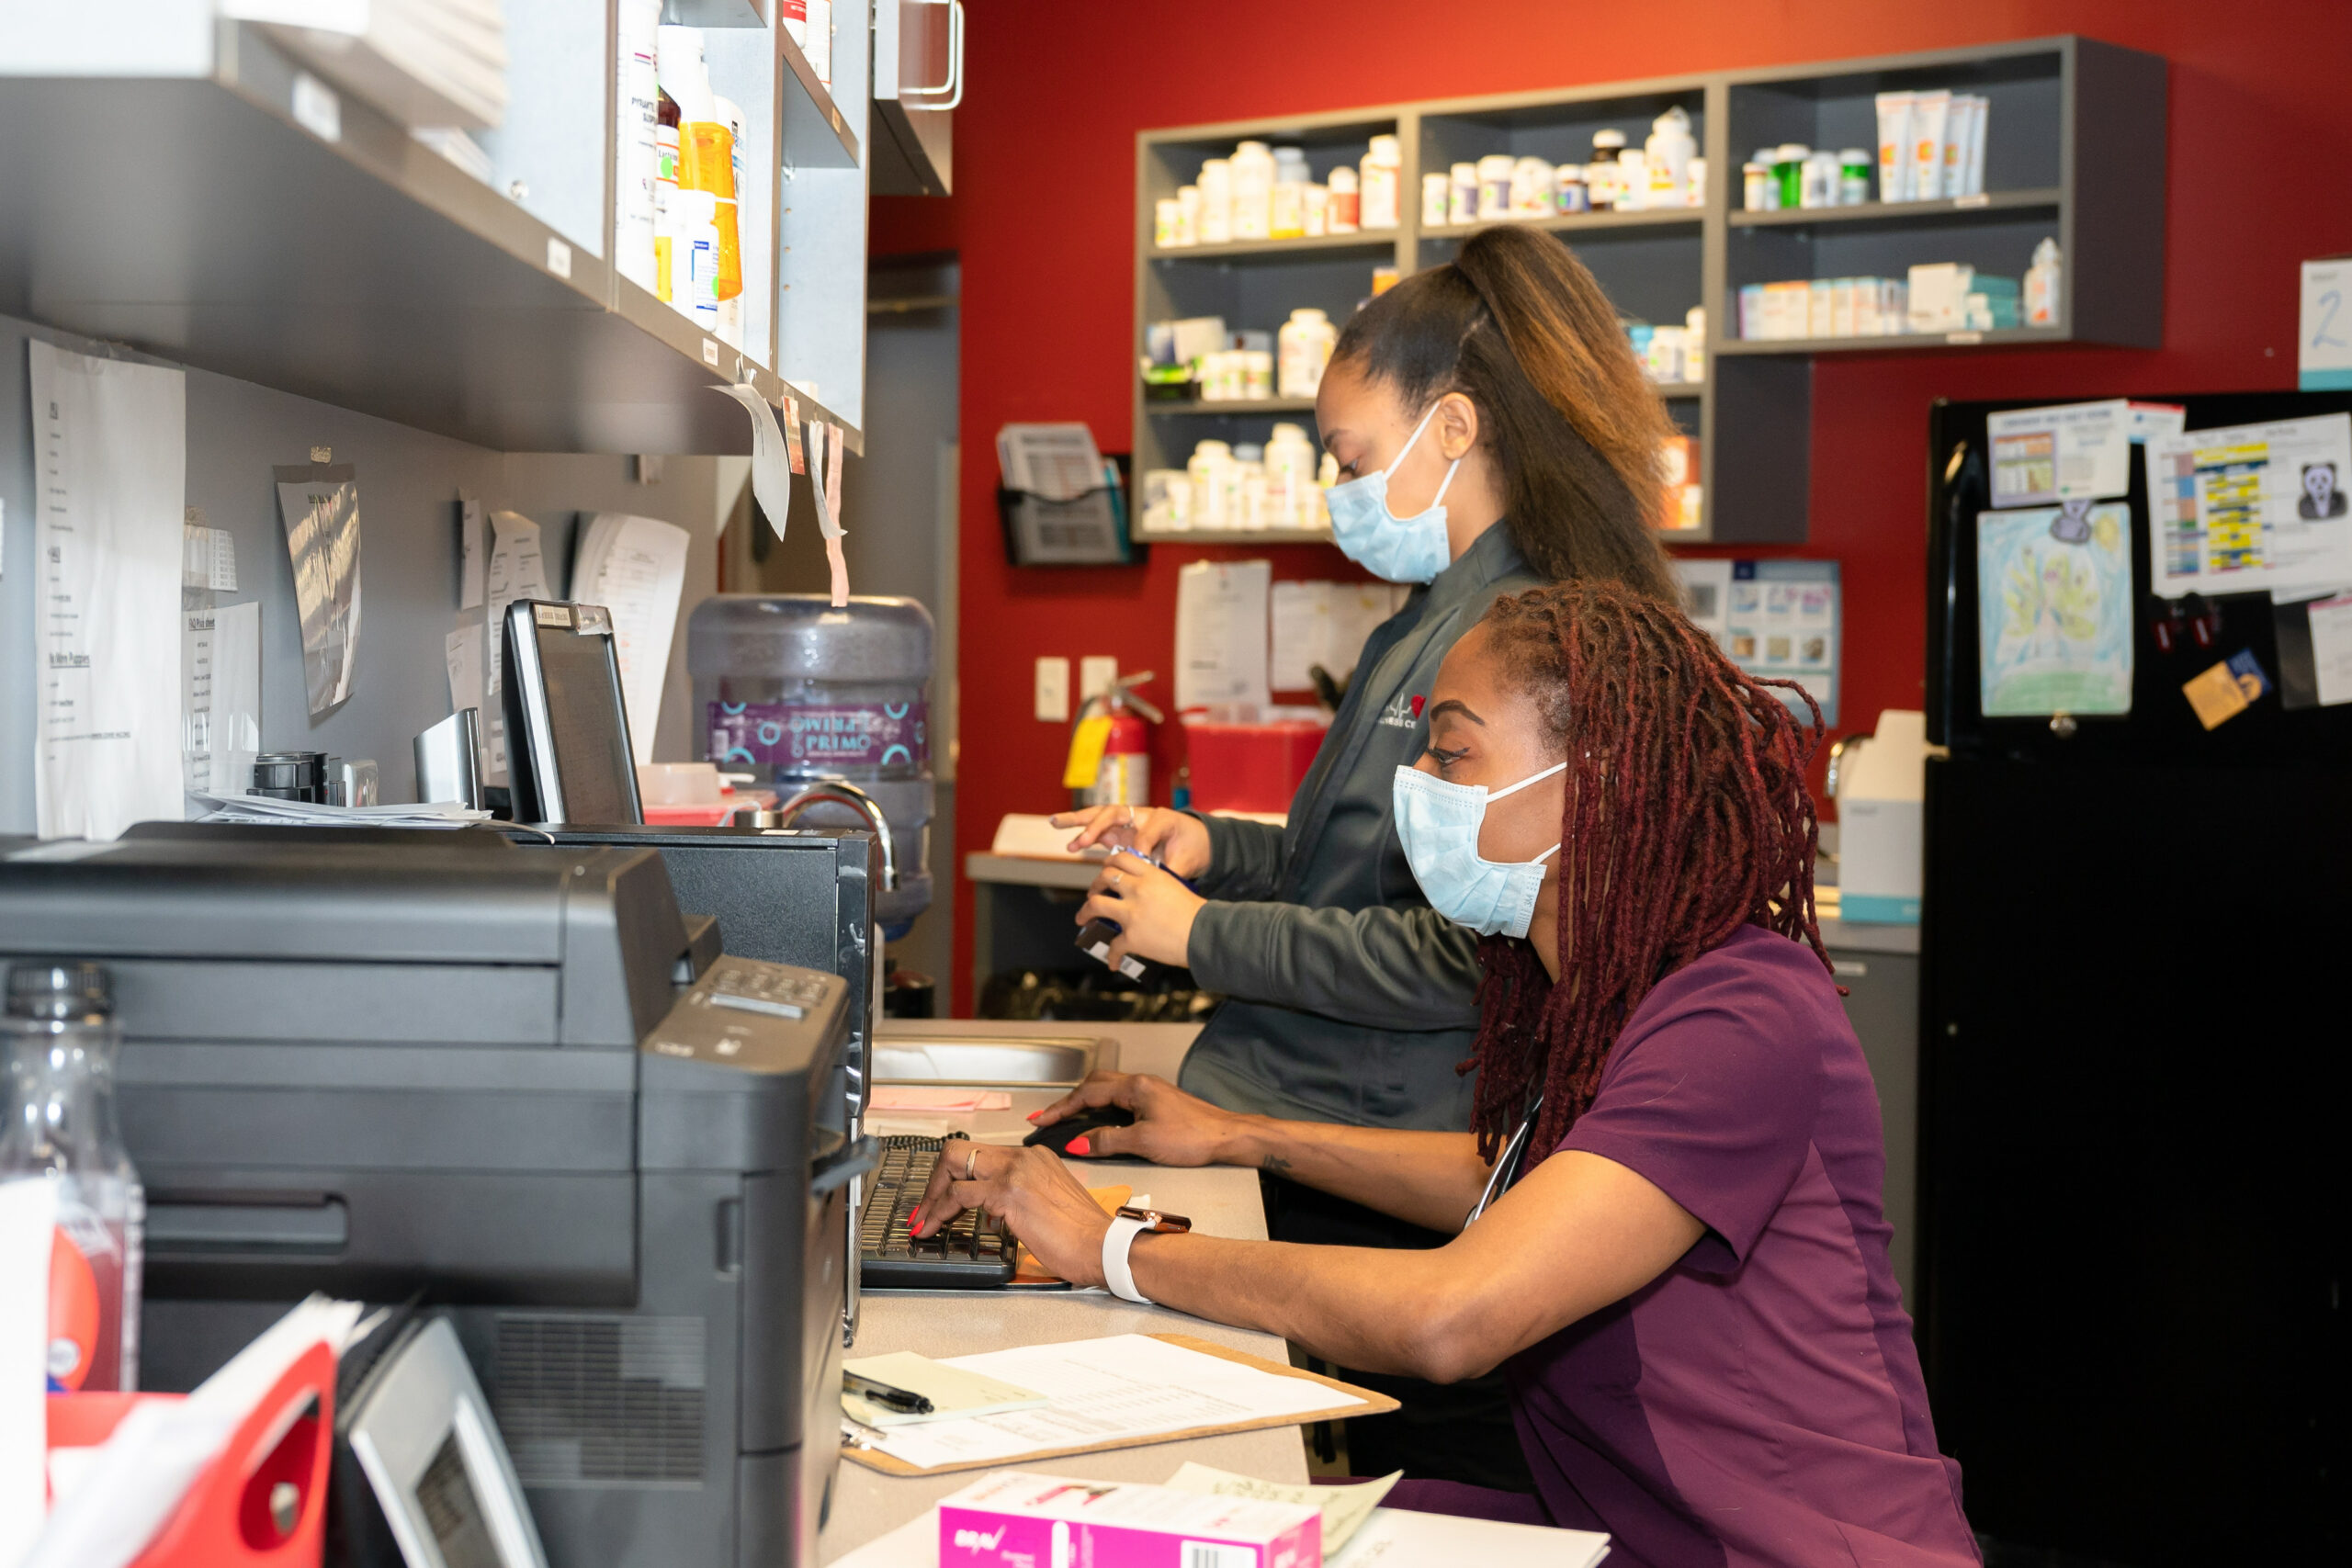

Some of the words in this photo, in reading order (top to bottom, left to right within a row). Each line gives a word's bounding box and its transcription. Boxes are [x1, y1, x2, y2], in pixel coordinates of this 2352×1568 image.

[2311, 289, 2347, 349] 2
[1405, 719, 1417, 729] CE
[806, 734, 871, 750] PRIMO
